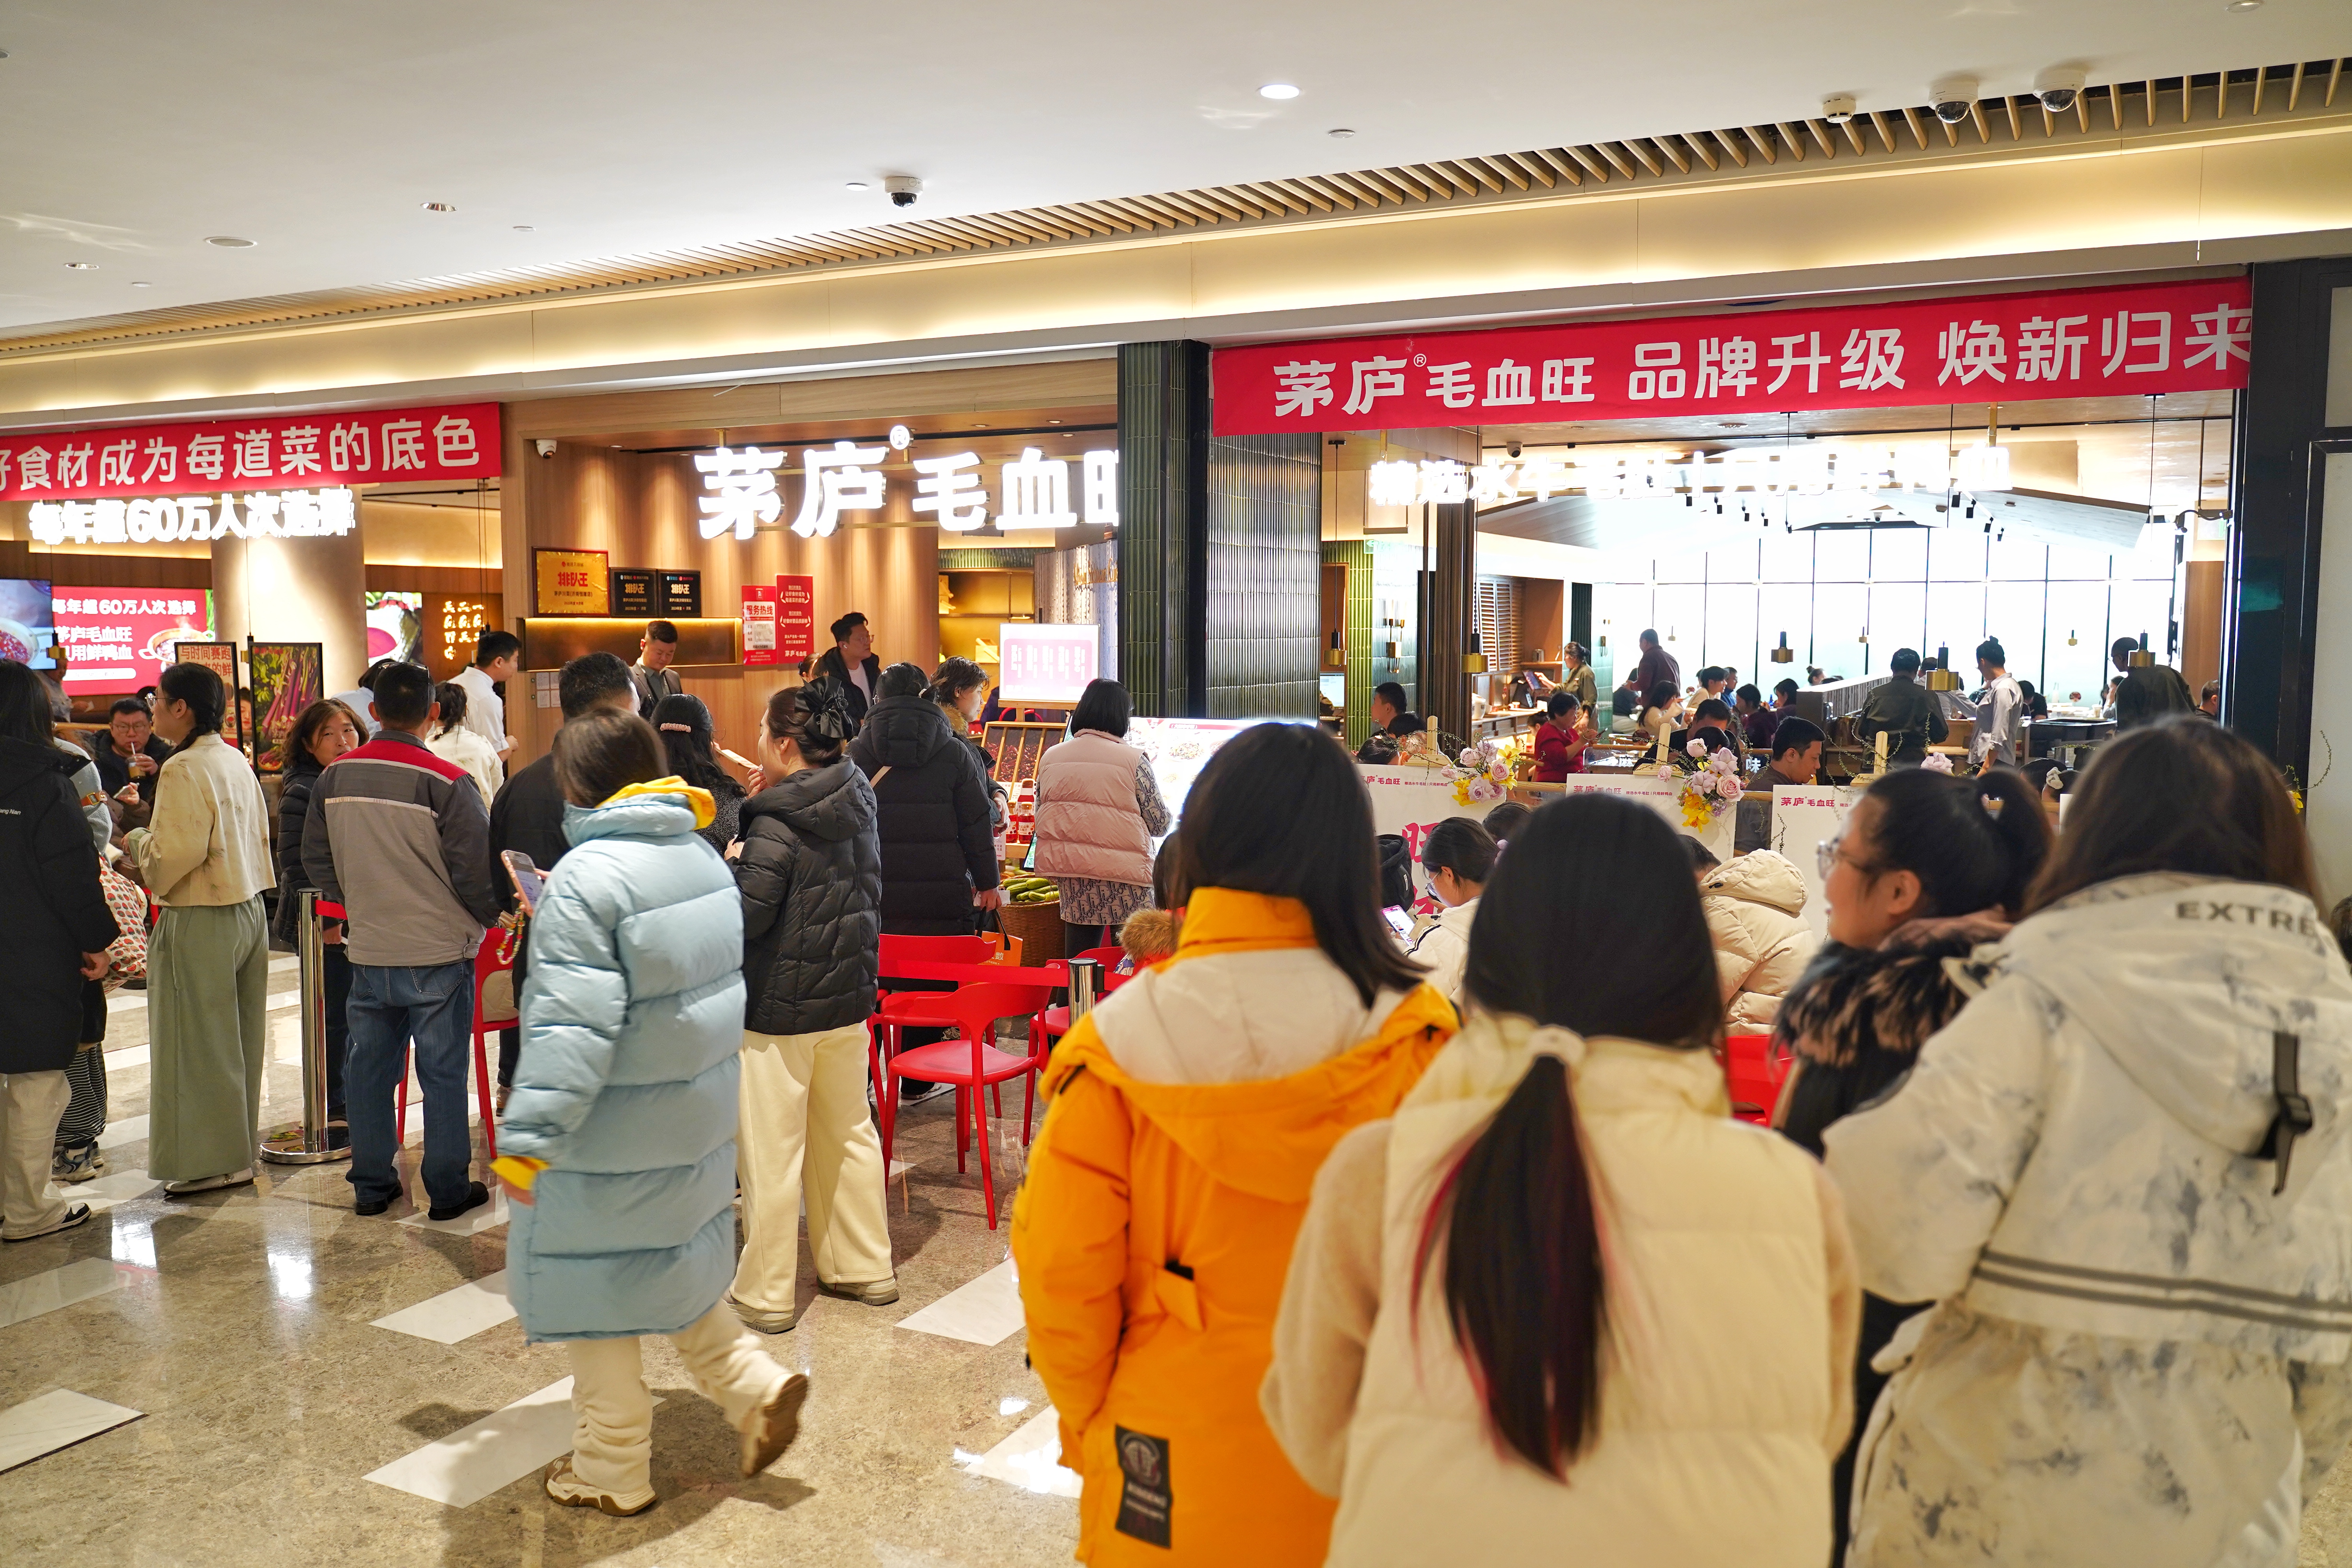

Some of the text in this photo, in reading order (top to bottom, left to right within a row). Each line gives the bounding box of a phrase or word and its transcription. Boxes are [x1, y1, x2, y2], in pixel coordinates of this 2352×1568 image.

[1628, 328, 1906, 400] 品牌升级
[1937, 303, 2252, 387] 焕新归来
[558, 572, 588, 587] 排队王
[671, 584, 690, 594] 排队王
[746, 605, 773, 615] 服务热线
[54, 625, 133, 643] 茅庐毛血旺
[181, 645, 232, 660] 与时间赛跑
